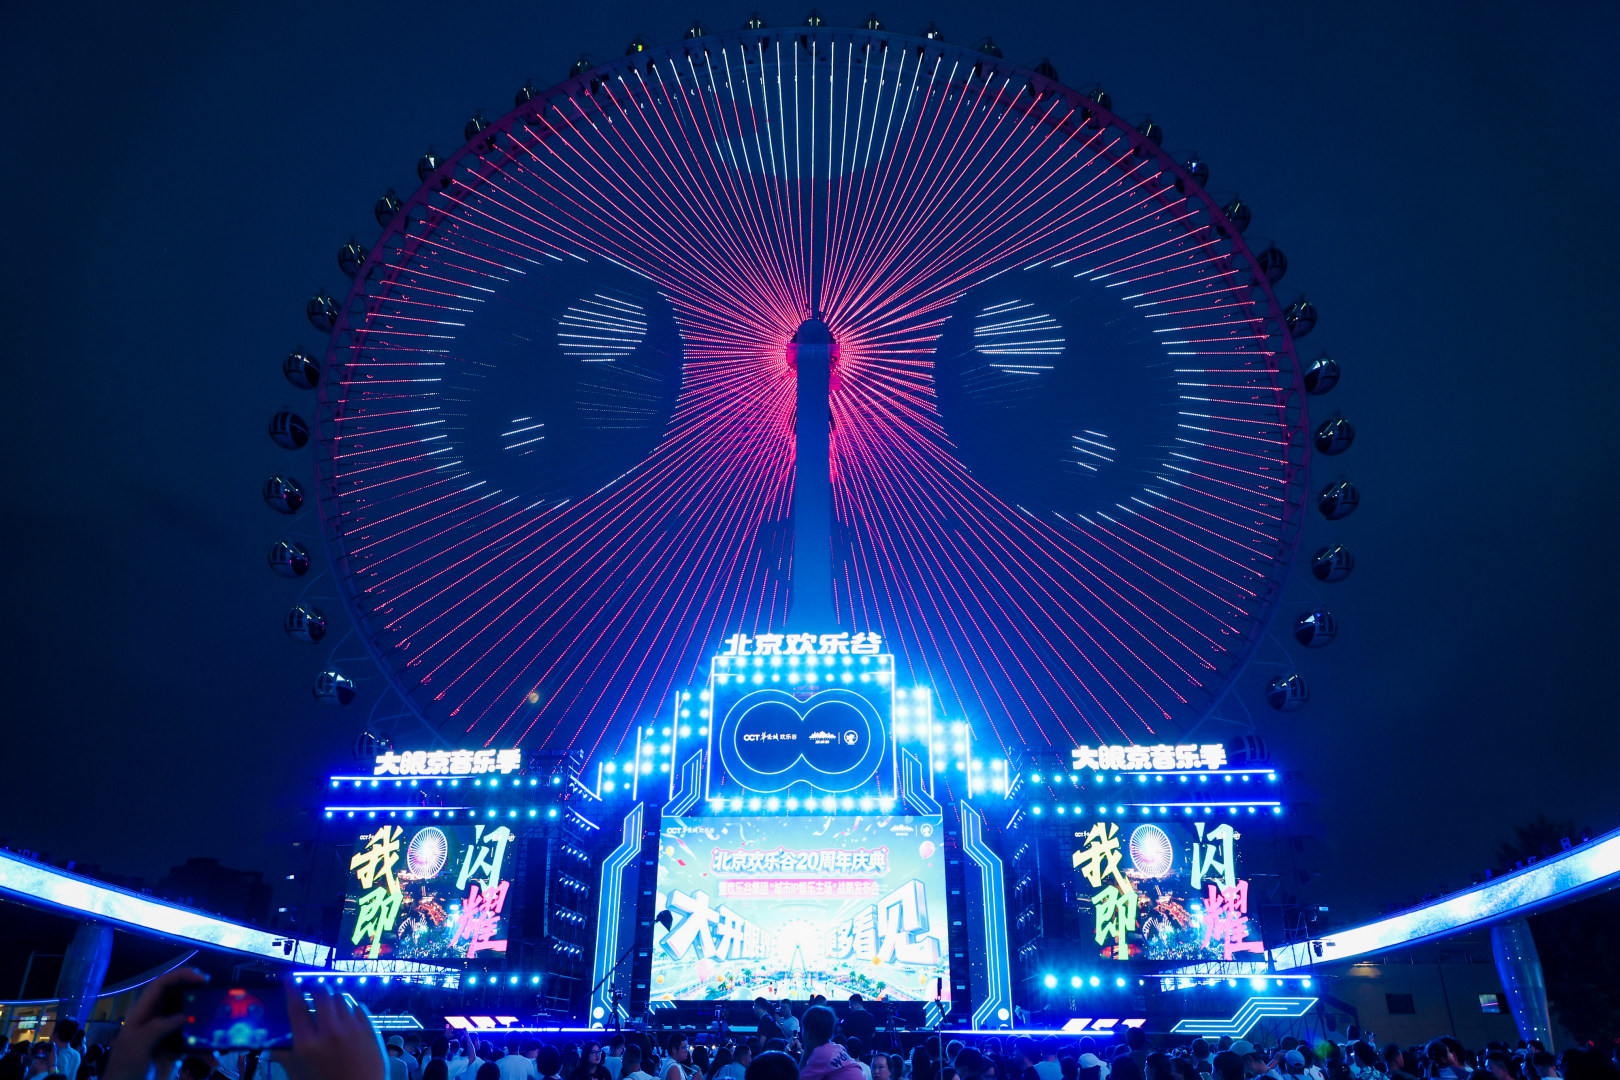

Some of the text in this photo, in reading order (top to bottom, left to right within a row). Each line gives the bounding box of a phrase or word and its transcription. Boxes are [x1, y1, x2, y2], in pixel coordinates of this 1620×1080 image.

[724, 632, 882, 655] 北京欢乐谷
[374, 749, 521, 775] 大眼京音乐季
[1071, 744, 1227, 770] 大眼京音乐季
[350, 825, 403, 959] 我即
[447, 825, 510, 959] 闪耀
[713, 850, 886, 872] 北京欢乐谷20周年庆典
[1072, 822, 1138, 960] 我即
[1190, 822, 1265, 960] 闪耀
